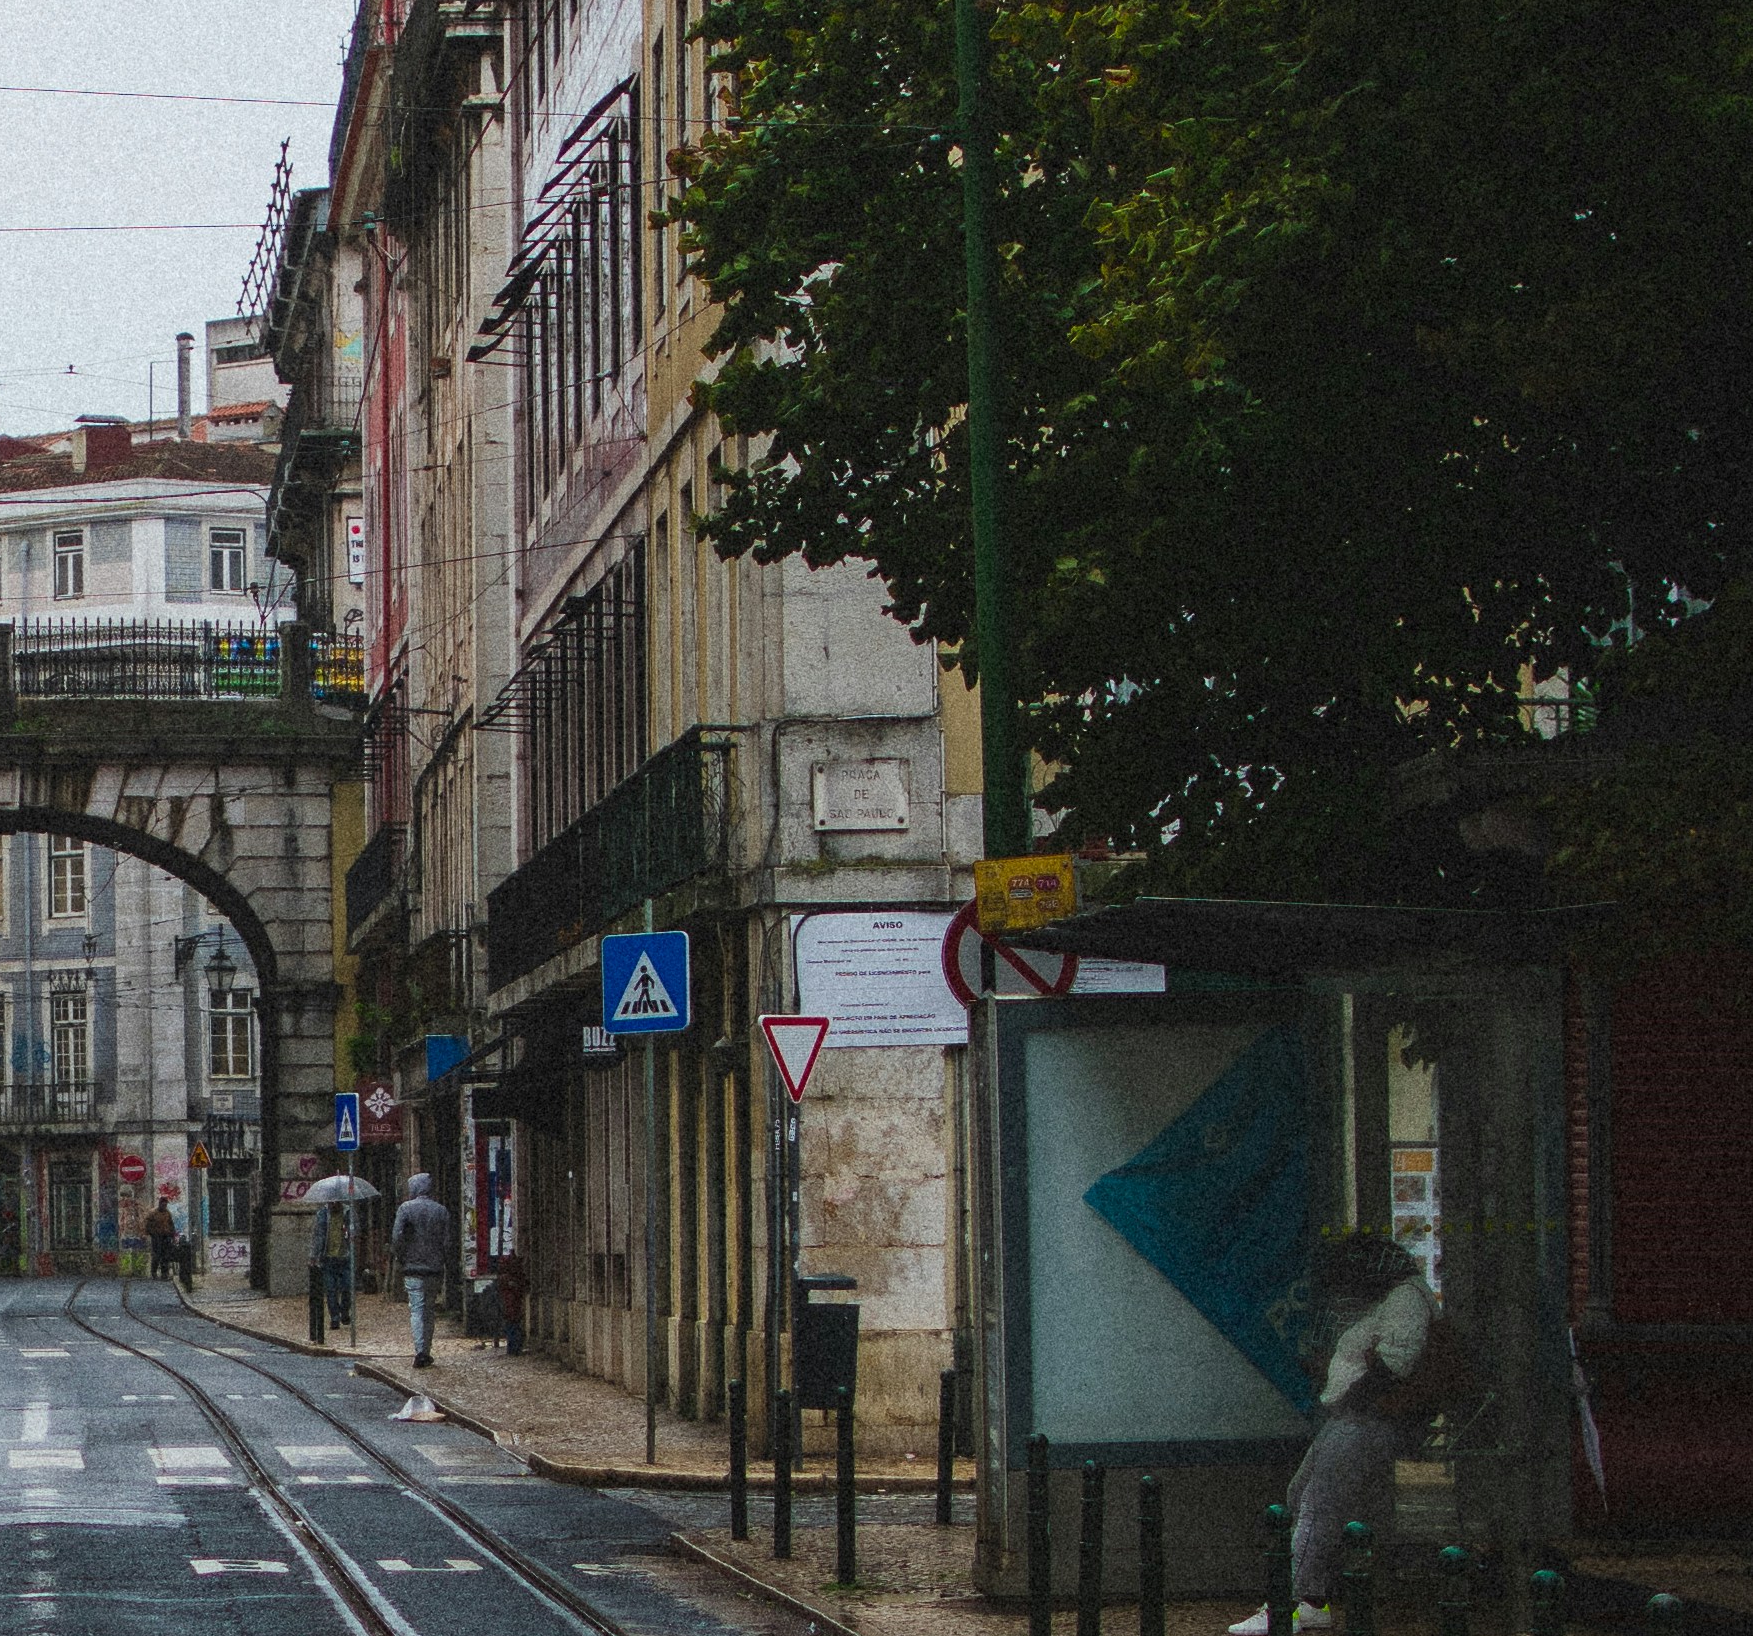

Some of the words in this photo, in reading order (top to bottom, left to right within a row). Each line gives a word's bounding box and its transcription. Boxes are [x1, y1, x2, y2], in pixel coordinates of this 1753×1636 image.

[853, 788, 870, 800] DE
[855, 807, 895, 819] PAULO
[872, 920, 904, 930] AVISO
